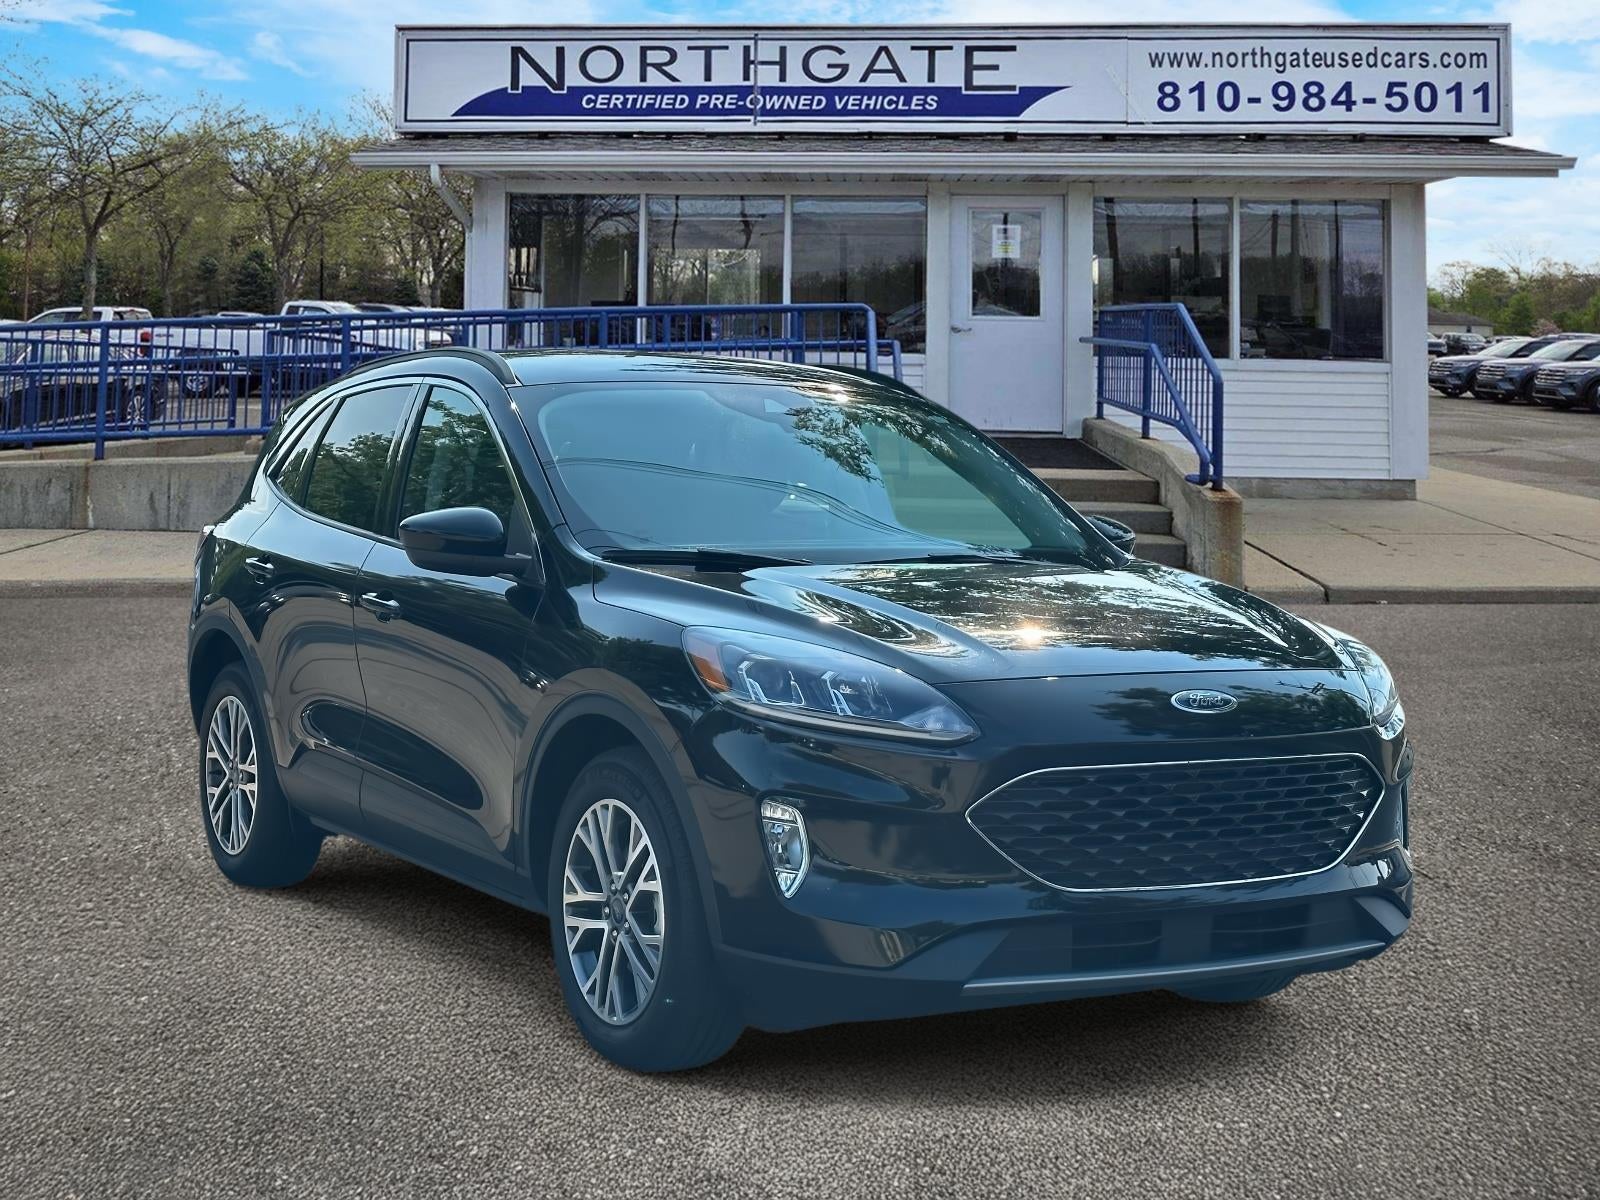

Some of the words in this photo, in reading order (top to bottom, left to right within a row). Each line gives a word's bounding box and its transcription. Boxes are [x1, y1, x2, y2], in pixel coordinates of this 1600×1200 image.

[510, 45, 1017, 92] NORTHGATE
[1148, 46, 1488, 74] www.northgateusedcars.com
[581, 94, 689, 109] CERTIFIED
[696, 94, 826, 109] PRE-OWNED
[834, 94, 938, 110] VEHICLES
[1157, 80, 1490, 112] 810-984-5011
[1189, 692, 1224, 706] Ford
